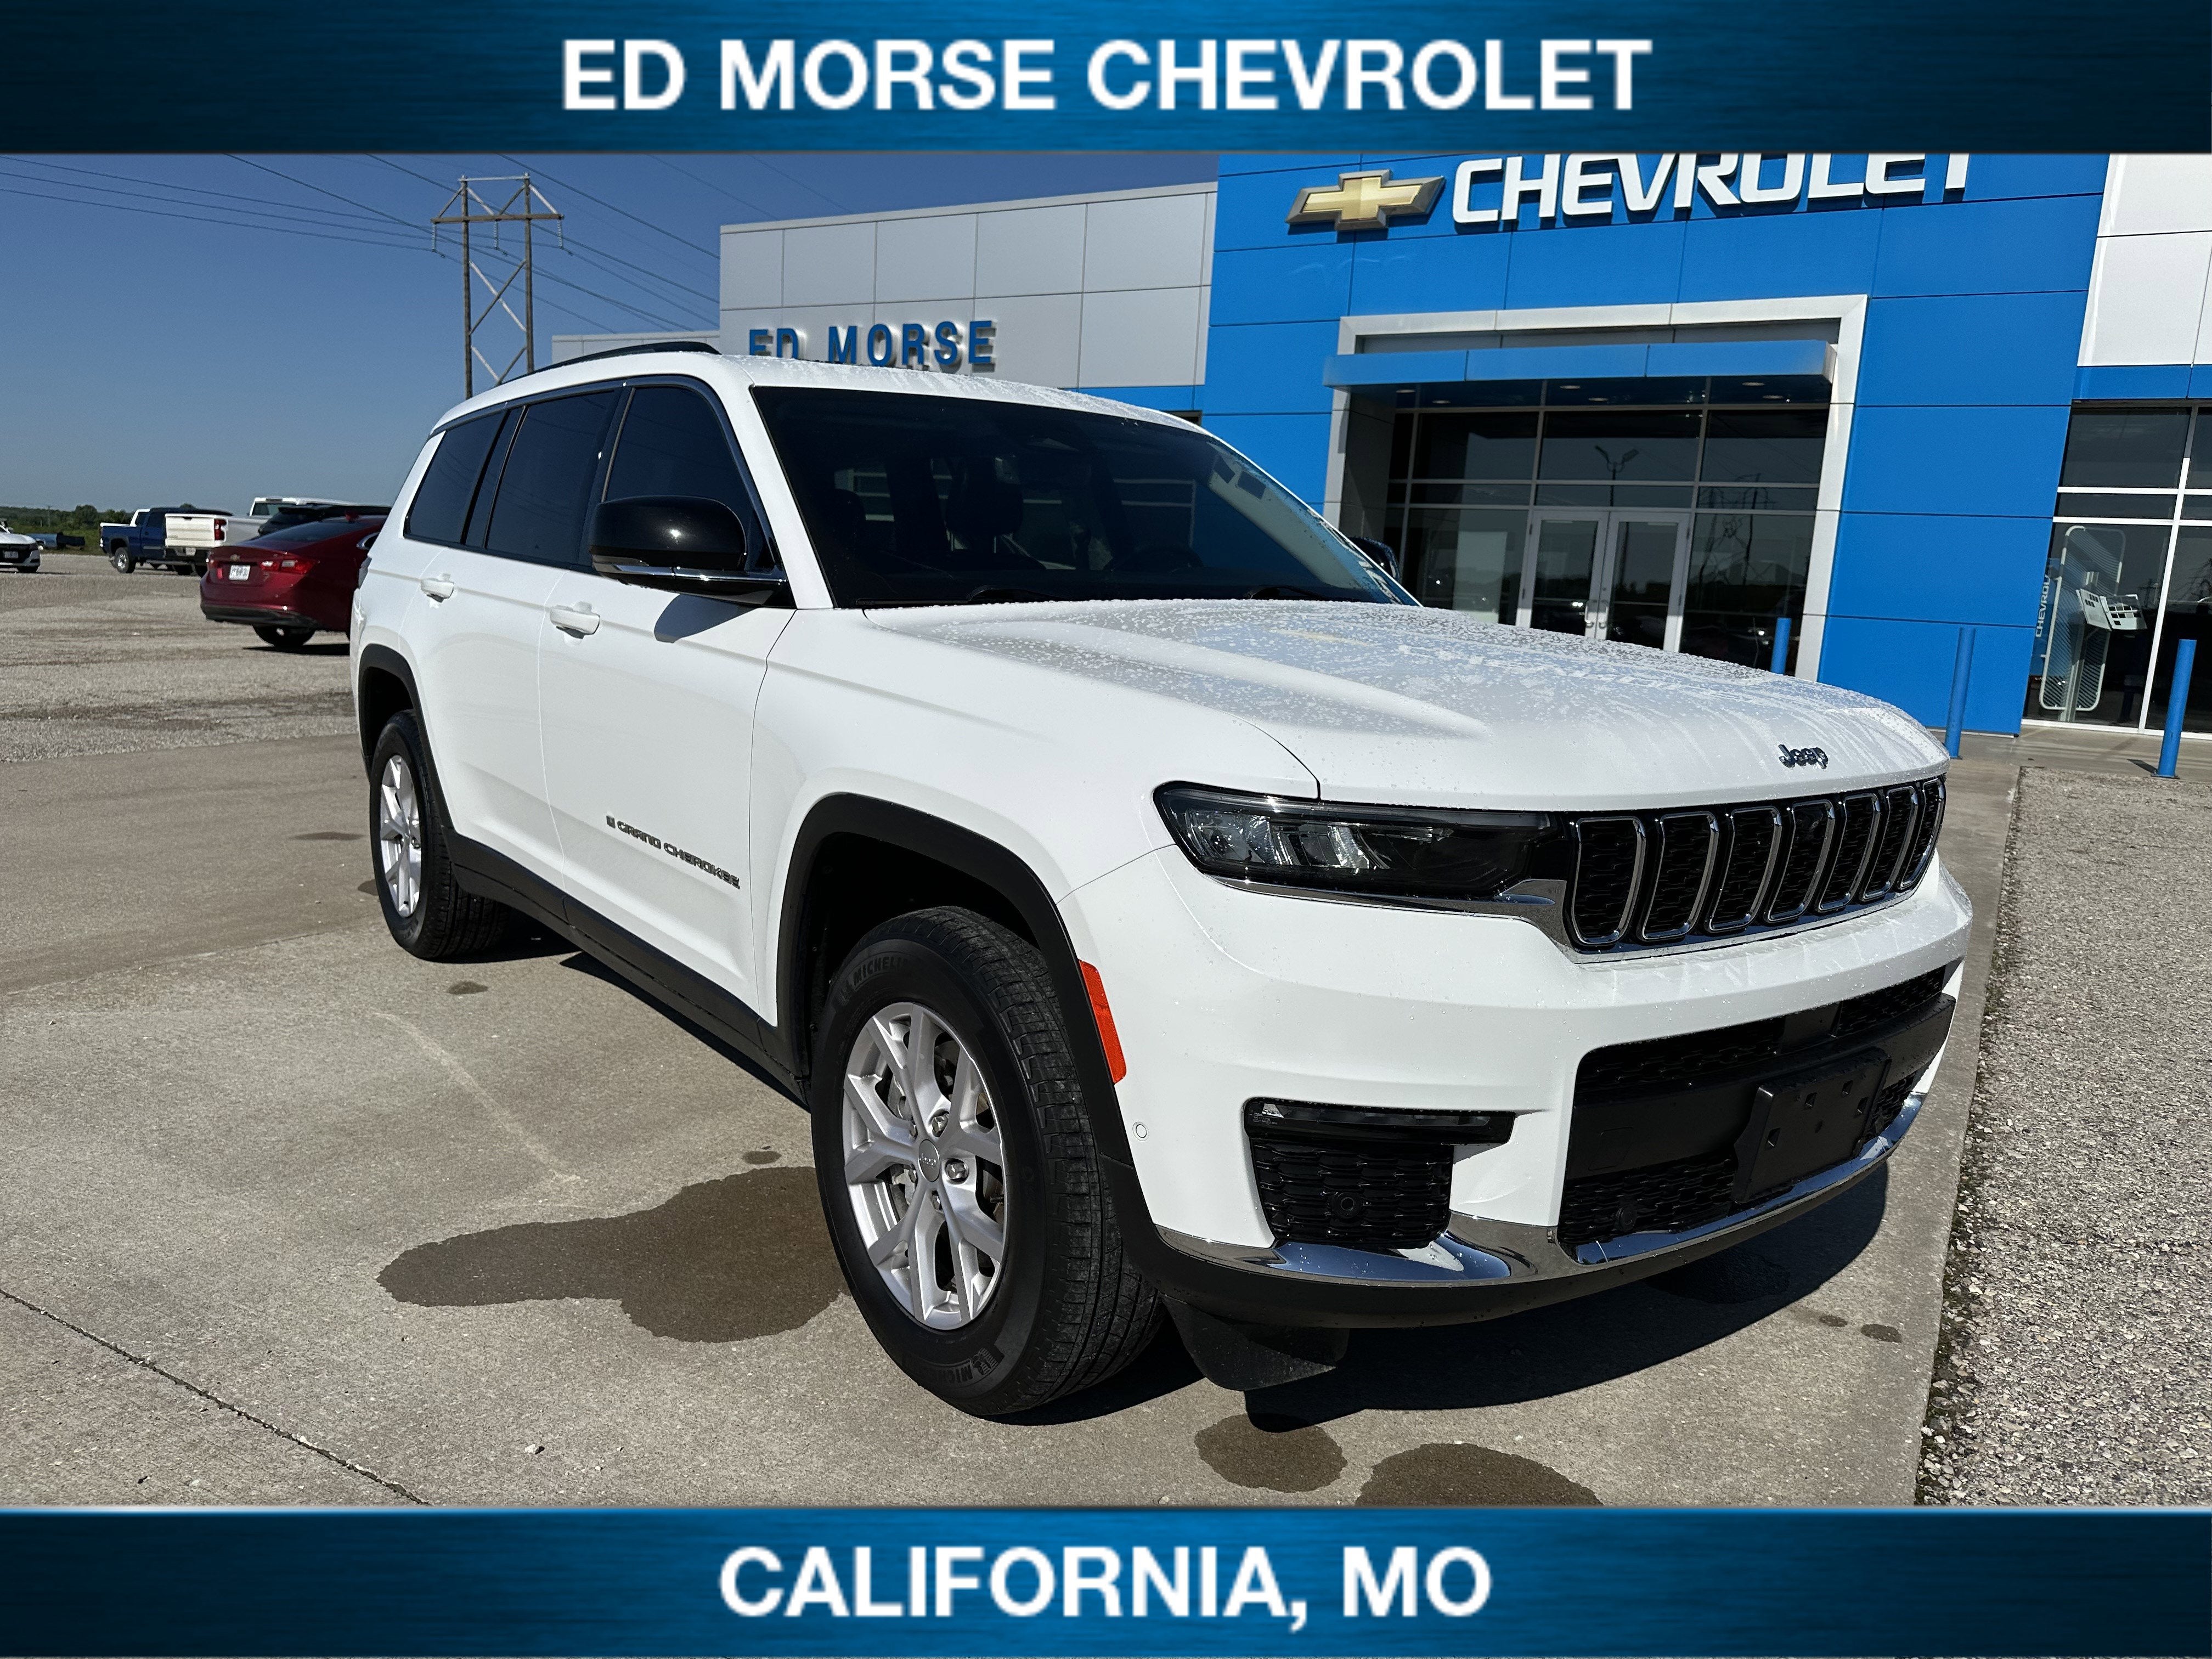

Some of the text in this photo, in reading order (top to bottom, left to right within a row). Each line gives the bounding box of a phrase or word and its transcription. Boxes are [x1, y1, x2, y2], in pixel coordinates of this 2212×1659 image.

[749, 320, 992, 366] ED MORSE
[2035, 574, 2050, 637] CHEVROL
[1778, 744, 1829, 769] Jeep
[617, 821, 740, 889] GRAND CHEROKEE
